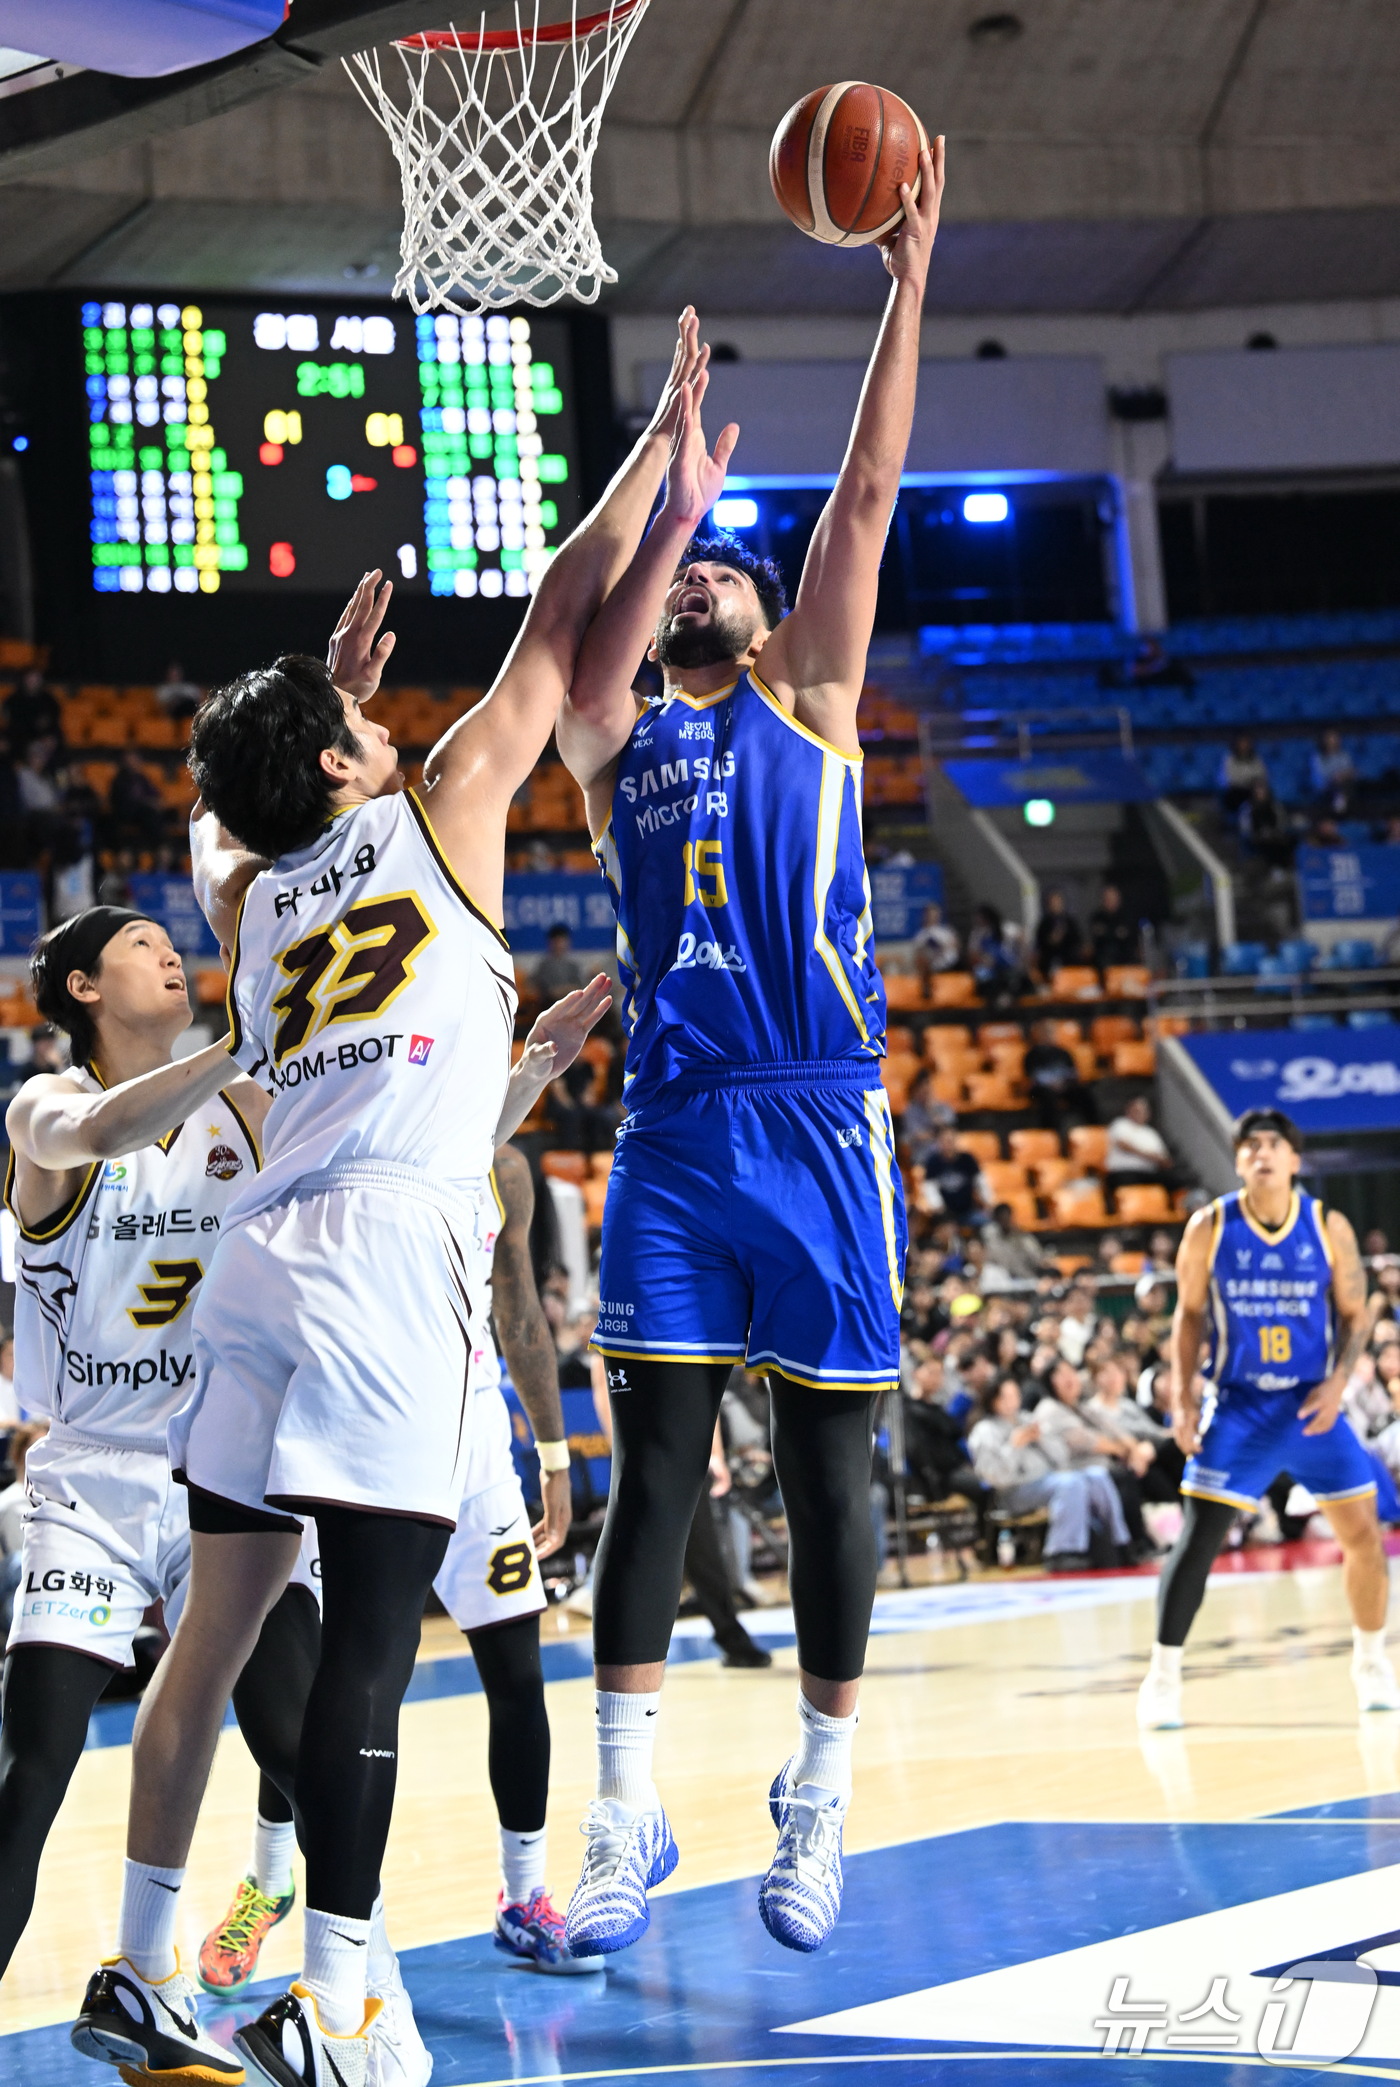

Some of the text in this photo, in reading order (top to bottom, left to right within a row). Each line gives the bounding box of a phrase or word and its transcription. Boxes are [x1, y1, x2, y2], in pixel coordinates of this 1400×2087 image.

[852, 126, 870, 163] FIBA
[632, 737, 654, 749] VEXX
[683, 839, 729, 908] 15
[271, 889, 440, 1068] 13
[111, 1209, 197, 1241] 올레드
[125, 1258, 206, 1329] 3
[604, 1319, 629, 1333] RGB
[1258, 1324, 1293, 1364] 18
[66, 1348, 197, 1391] Simply.
[25, 1569, 117, 1602] LG 화학
[485, 1539, 534, 1598] 8
